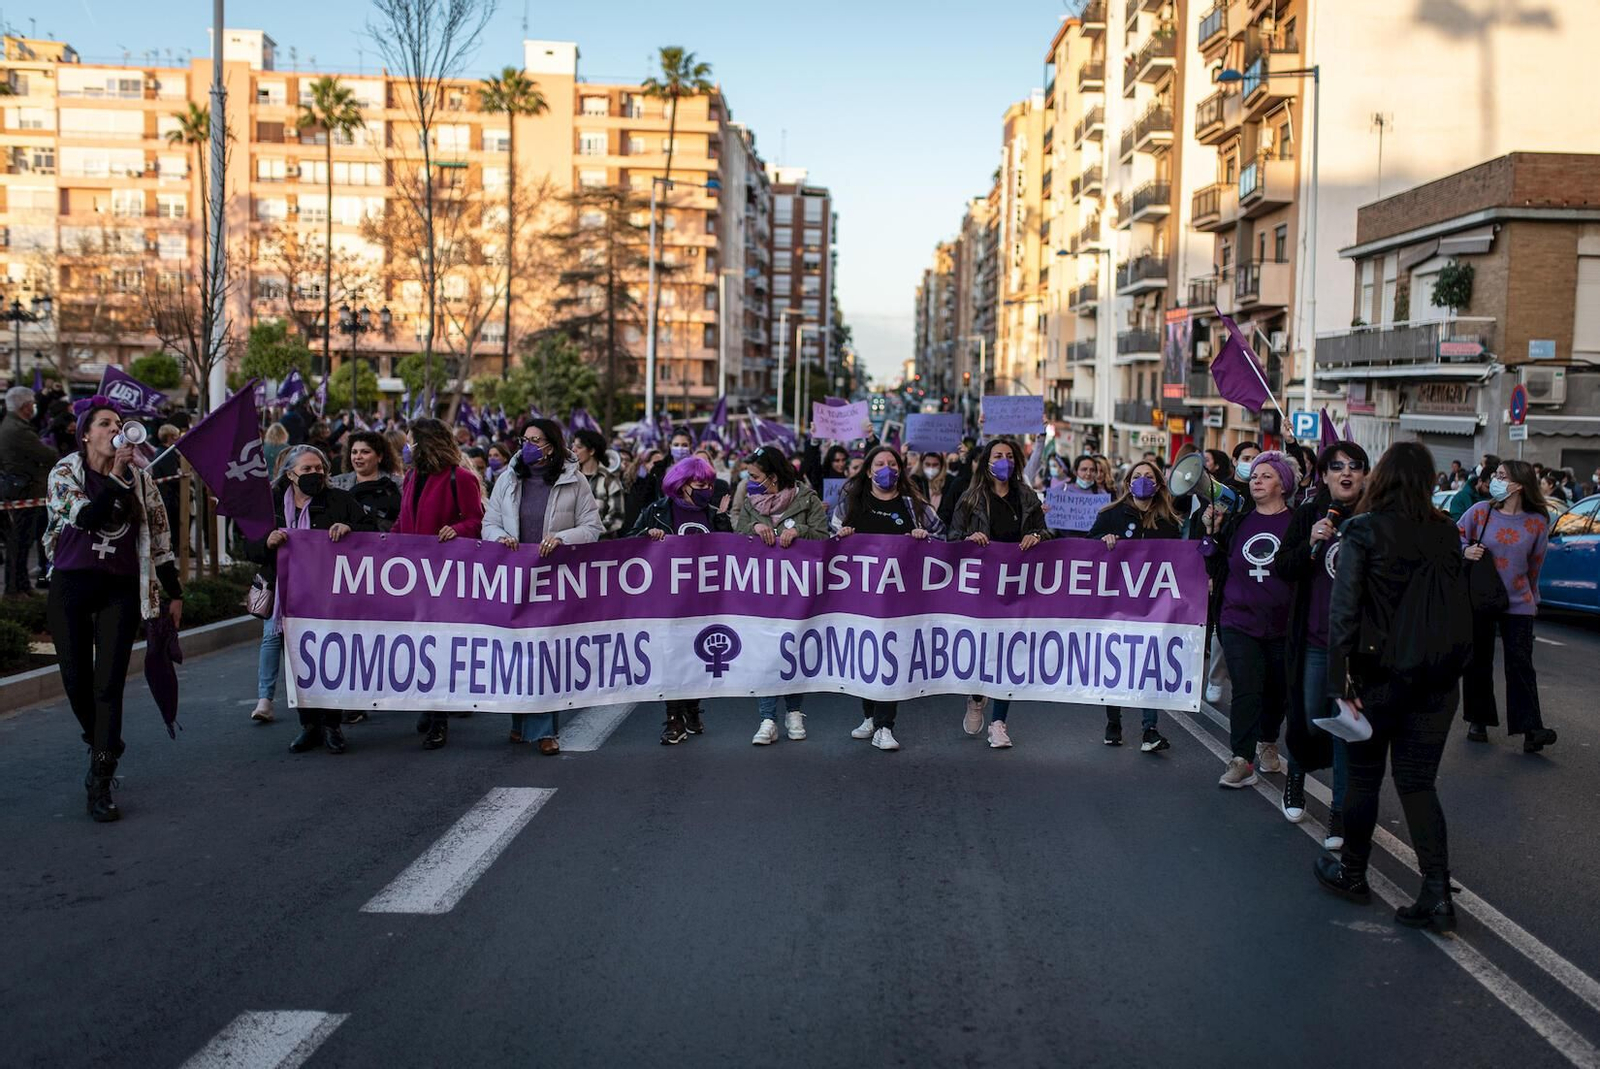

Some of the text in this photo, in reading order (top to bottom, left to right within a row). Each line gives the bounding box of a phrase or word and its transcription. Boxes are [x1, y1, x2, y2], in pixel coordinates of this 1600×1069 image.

[109, 383, 140, 408] UGT
[1297, 414, 1313, 436] P
[332, 554, 1181, 603] MOVIMIENTO FEMINISTA DE HUELVA
[297, 626, 1193, 697] SOMOS FEMINISTAS SOMOS ABOLICIONISTAS.
